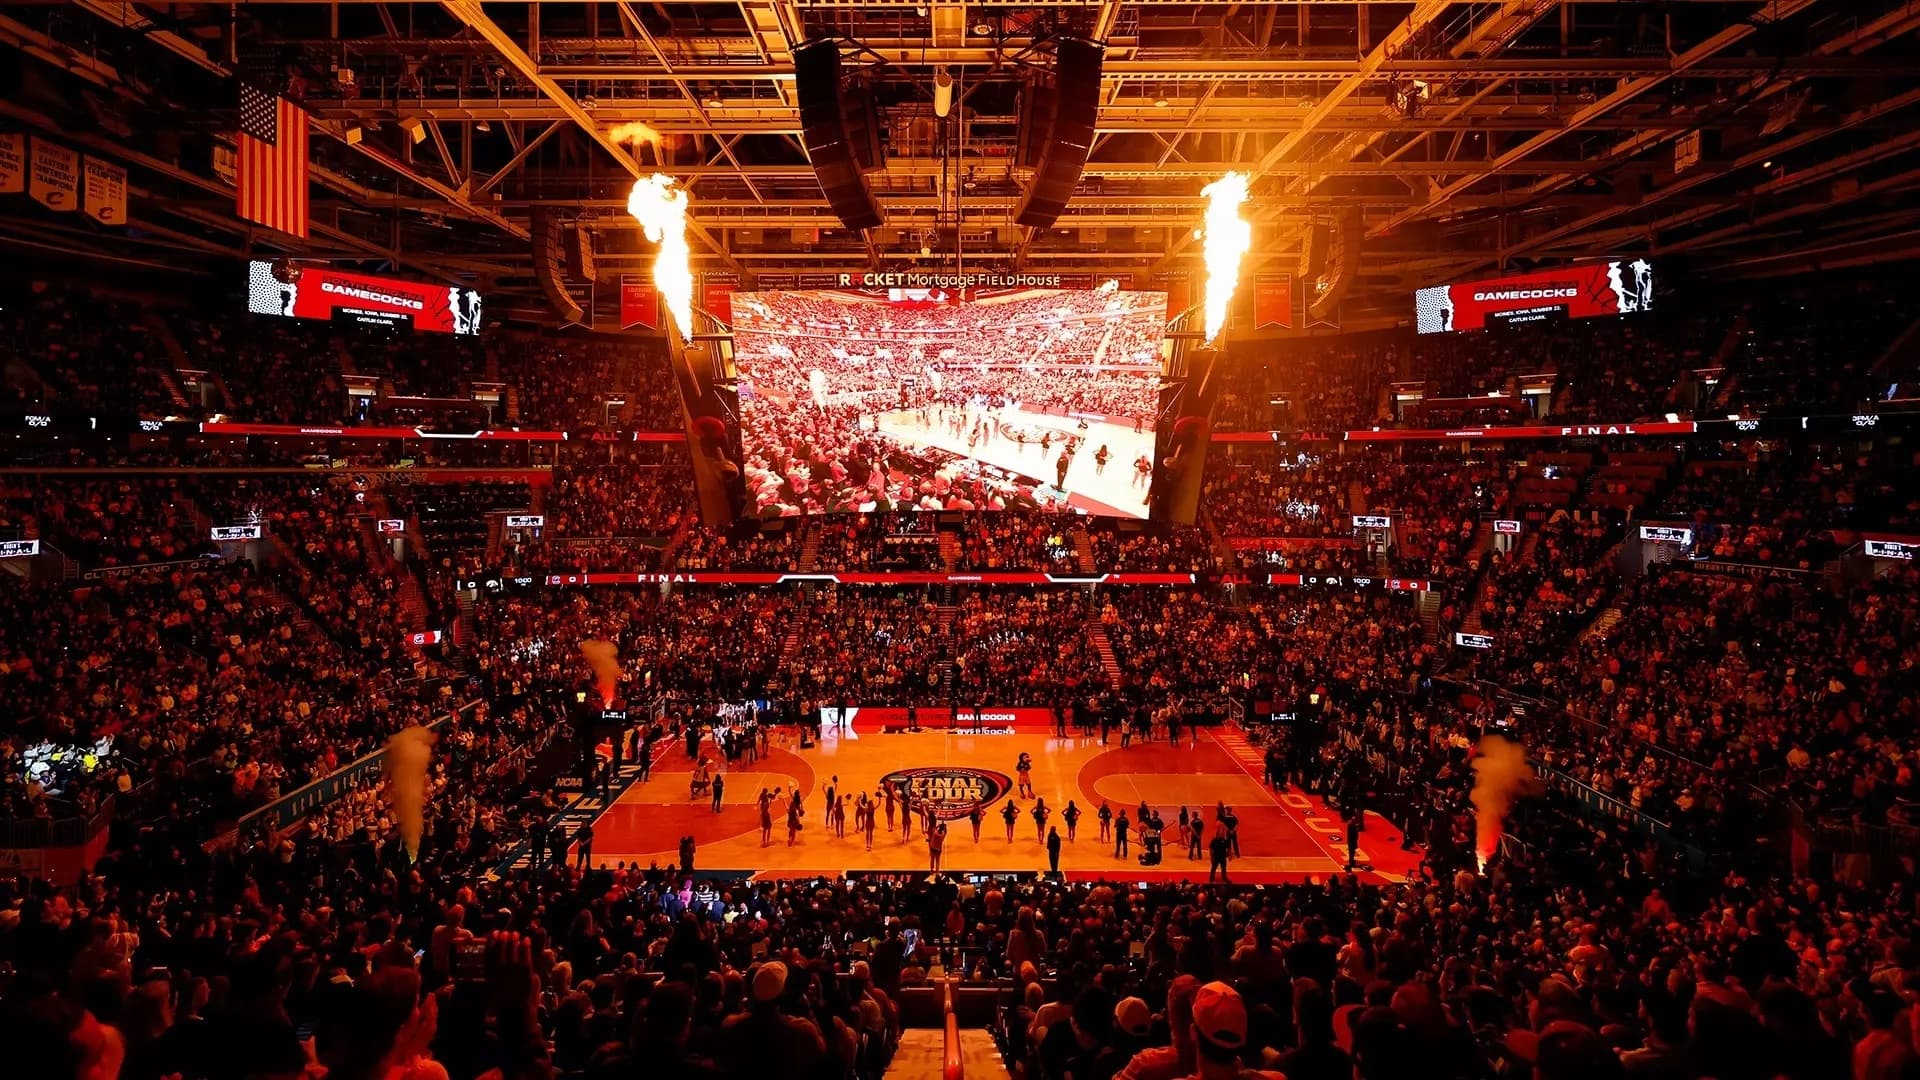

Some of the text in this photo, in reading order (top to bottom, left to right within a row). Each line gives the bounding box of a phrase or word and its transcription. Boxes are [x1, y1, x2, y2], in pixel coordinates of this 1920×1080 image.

[907, 272, 976, 289] Mortgage
[321, 282, 423, 310] GAMECOCKS
[1474, 288, 1578, 301] GAMECOCKS
[1561, 425, 1636, 435] FINAL
[638, 574, 697, 583] FINAL
[556, 777, 583, 788] NCAA
[911, 777, 982, 788] FINAL
